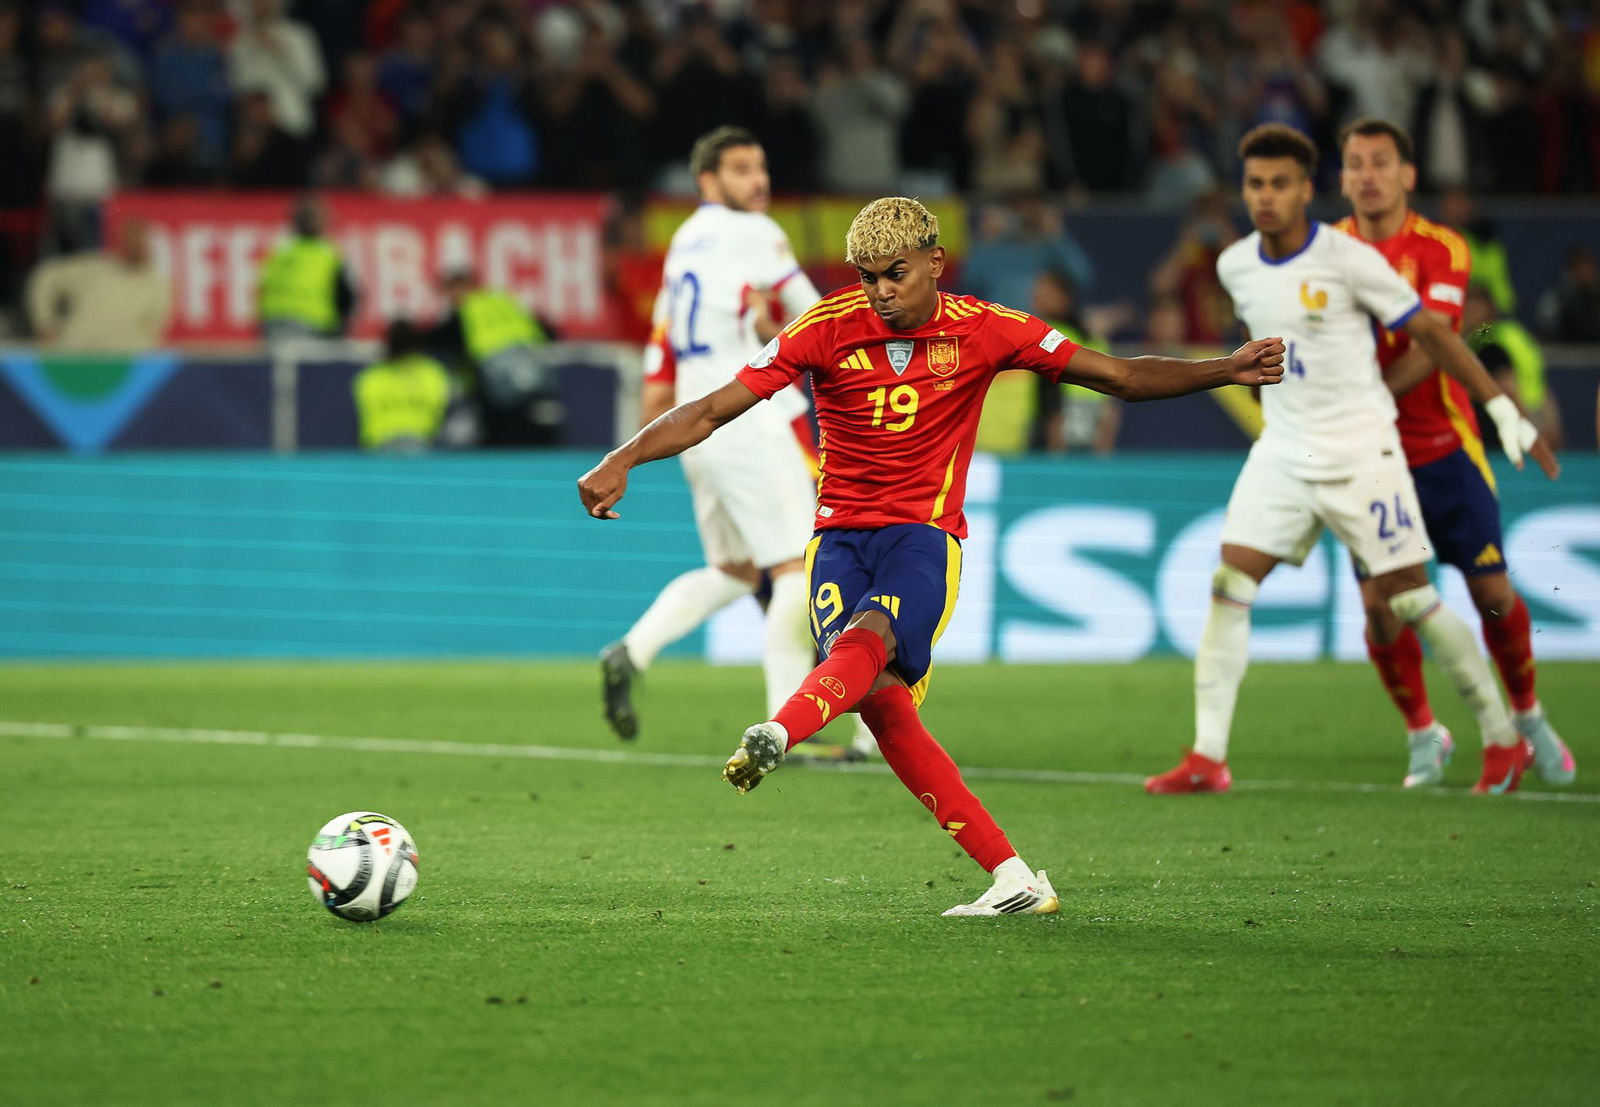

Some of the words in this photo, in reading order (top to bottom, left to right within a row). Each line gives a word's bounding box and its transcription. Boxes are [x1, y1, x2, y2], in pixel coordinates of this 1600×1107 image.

[146, 218, 602, 328] FFBACH
[867, 384, 920, 432] 19
[1370, 493, 1412, 539] 24
[810, 582, 845, 639] 19
